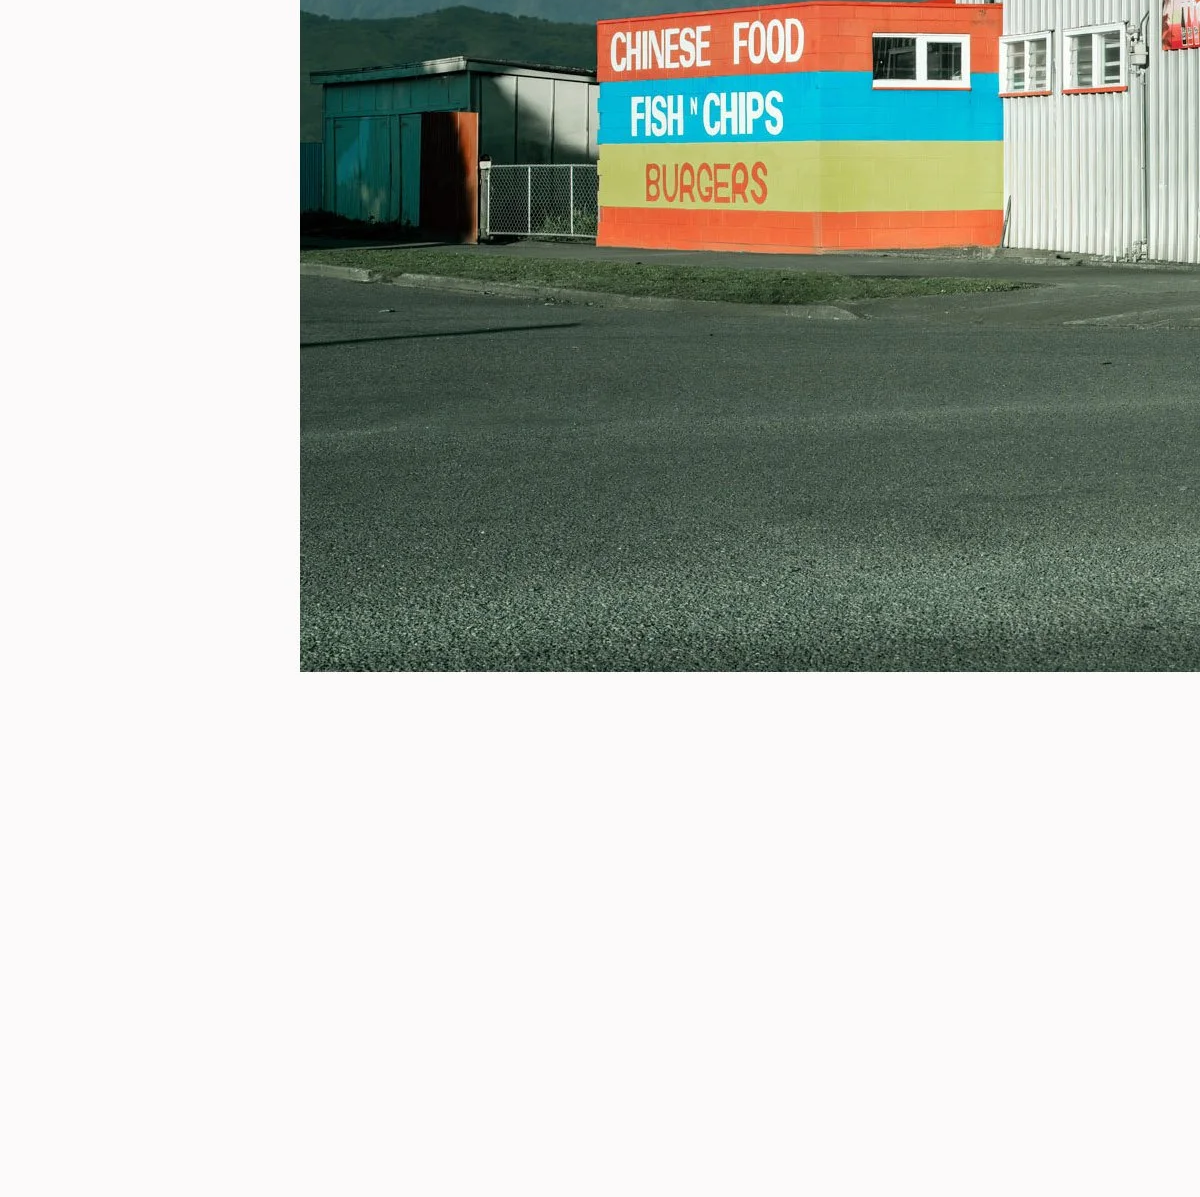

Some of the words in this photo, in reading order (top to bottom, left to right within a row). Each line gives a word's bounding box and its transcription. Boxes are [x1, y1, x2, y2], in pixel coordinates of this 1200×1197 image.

[610, 25, 711, 72] CHINESE
[733, 18, 805, 65] FOOD
[631, 94, 684, 137] FISH
[690, 97, 698, 116] N
[703, 90, 784, 136] CHIPS
[645, 161, 768, 205] BURGERS
